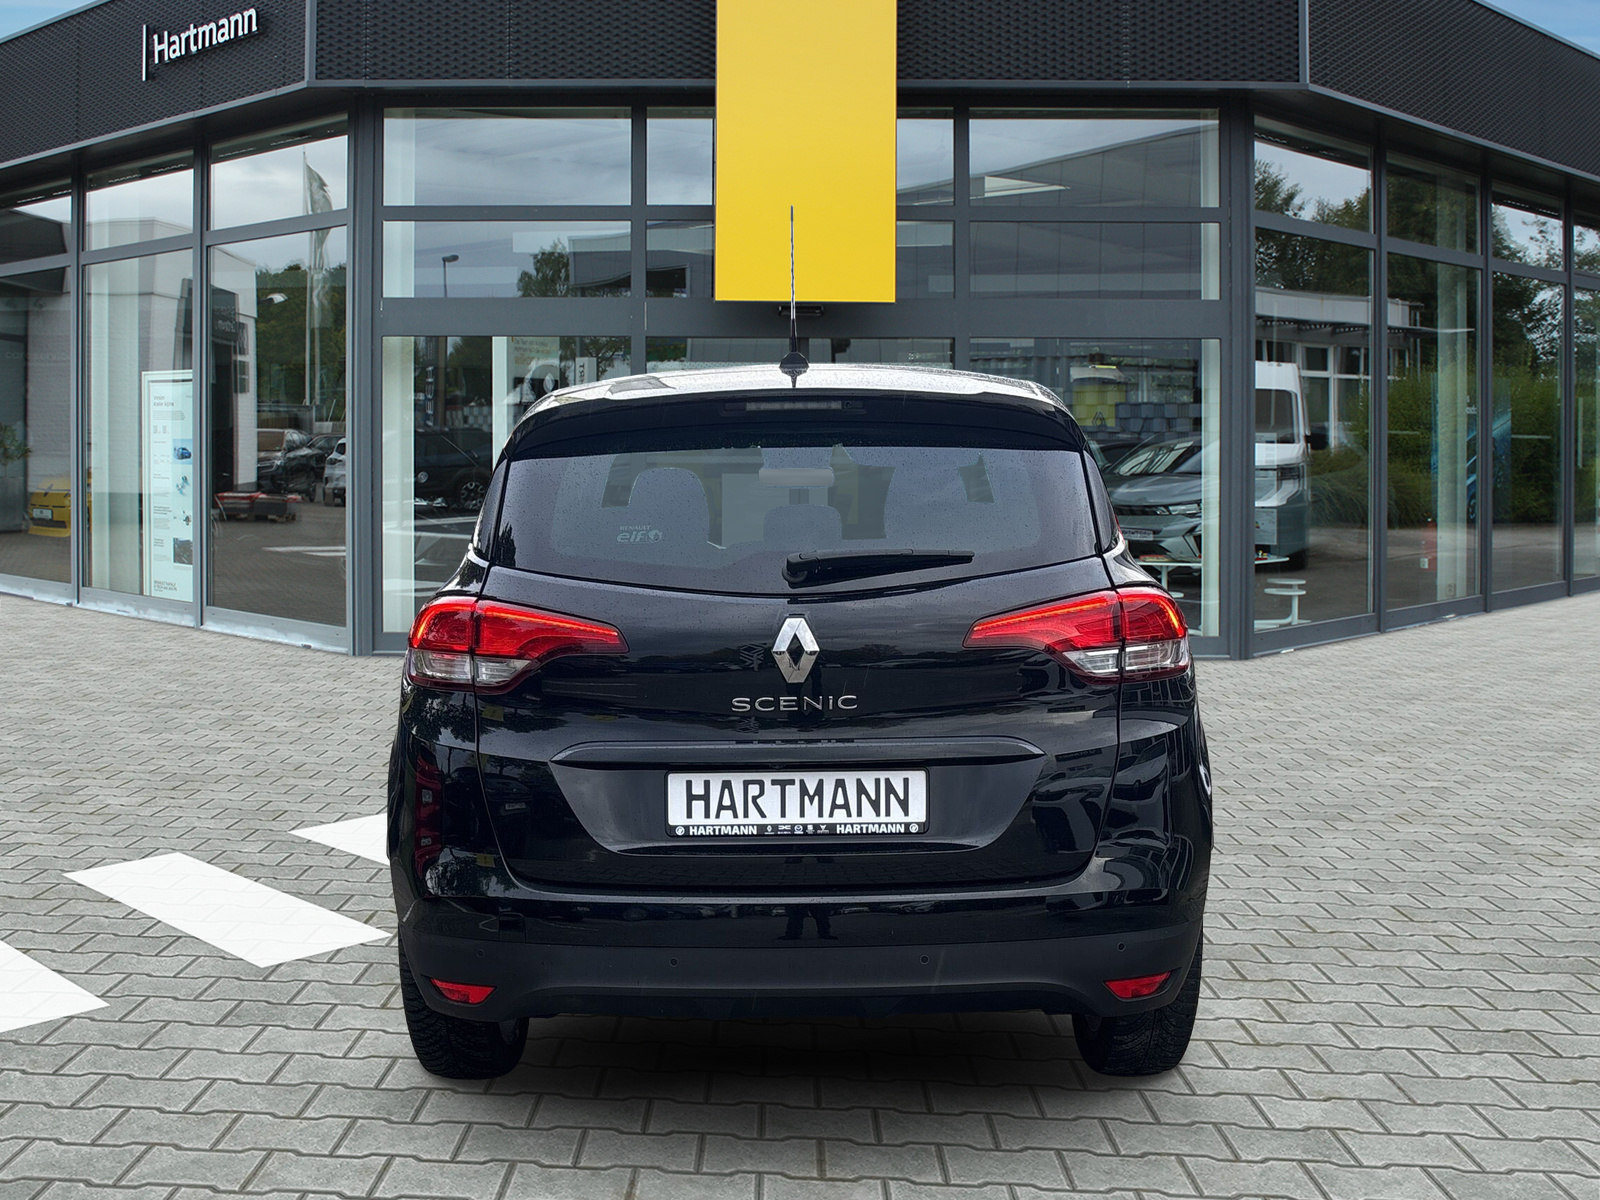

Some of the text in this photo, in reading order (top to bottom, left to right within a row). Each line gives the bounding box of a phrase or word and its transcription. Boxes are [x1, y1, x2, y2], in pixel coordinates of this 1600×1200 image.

[152, 7, 258, 65] Hartmann
[685, 777, 910, 819] HARTMANN
[689, 823, 905, 835] HARTMANN HARTMANN
